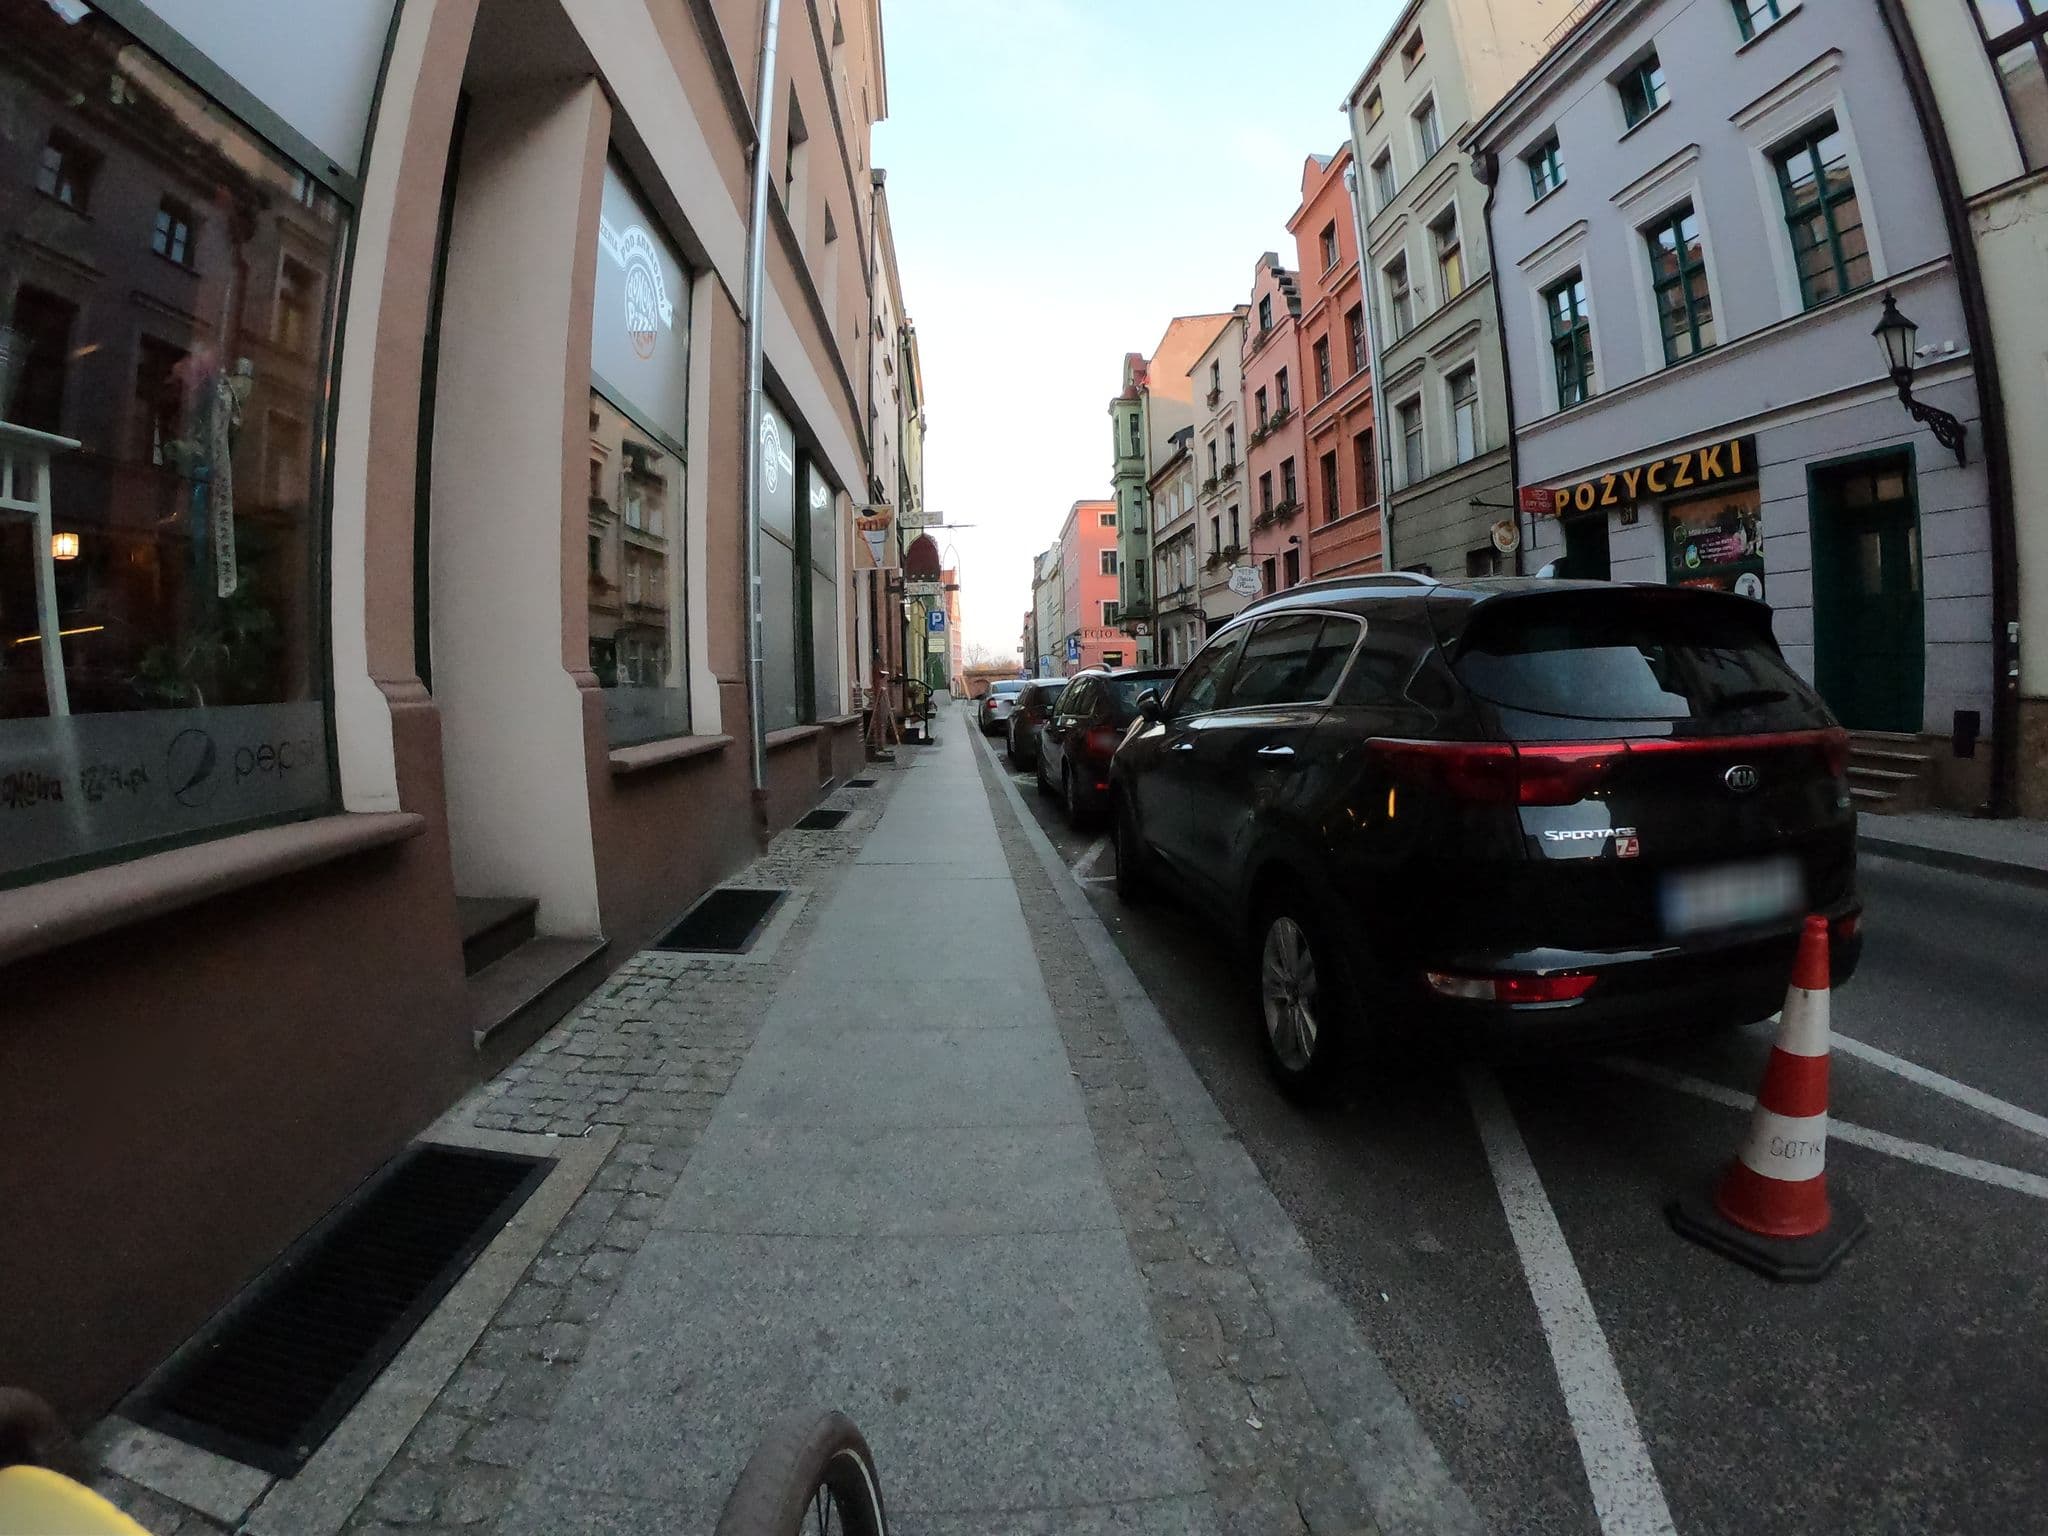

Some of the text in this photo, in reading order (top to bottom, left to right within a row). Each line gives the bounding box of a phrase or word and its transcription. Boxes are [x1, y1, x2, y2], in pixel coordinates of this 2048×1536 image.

[1554, 439, 1742, 517] POŻYCZKI
[932, 612, 942, 626] P
[1731, 770, 1755, 788] KIA
[1544, 827, 1638, 842] SPORTAGE
